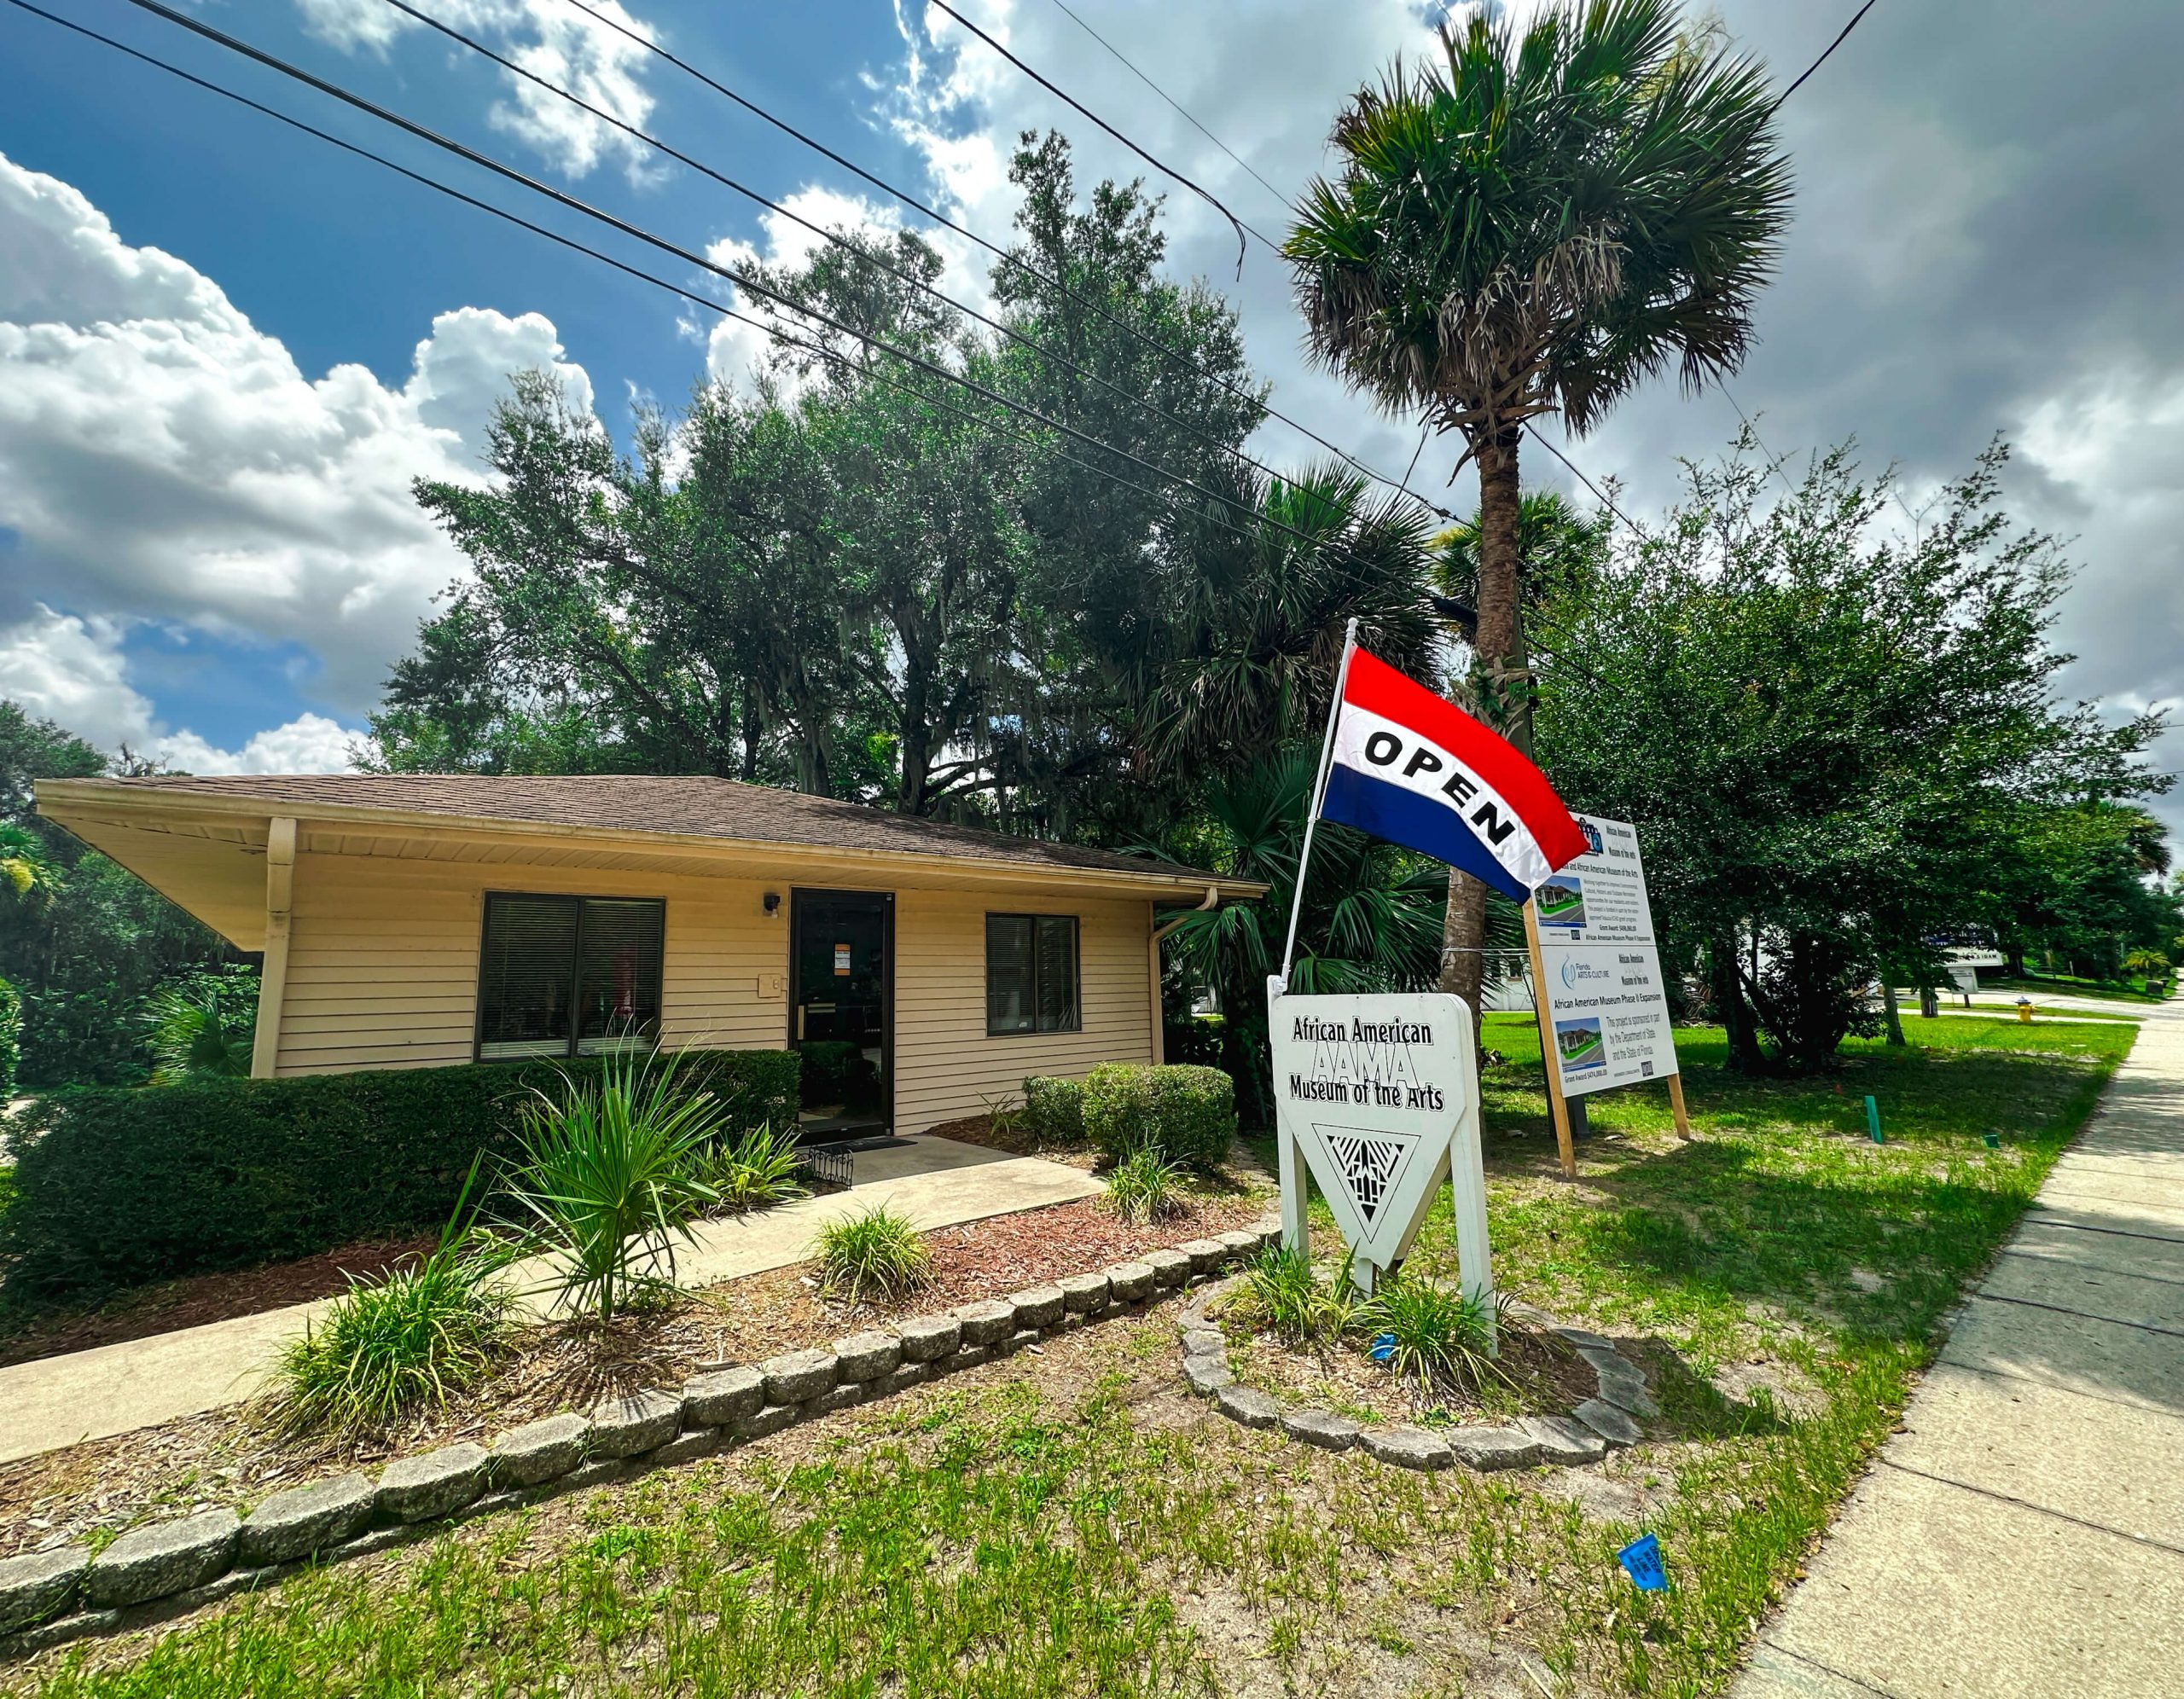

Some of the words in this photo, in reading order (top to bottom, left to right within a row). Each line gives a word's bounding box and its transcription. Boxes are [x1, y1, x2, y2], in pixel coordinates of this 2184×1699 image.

[1365, 731, 1515, 846] OPEN
[1577, 862, 1589, 872] African
[1590, 864, 1606, 873] American
[1577, 962, 1590, 971] Florida
[1578, 971, 1589, 979] ARTS
[1592, 970, 1611, 978] CULTURE
[1554, 999, 1574, 1010] African
[1575, 996, 1599, 1008] American
[1600, 995, 1621, 1006] Museum
[1621, 994, 1635, 1004] Phase
[1640, 993, 1662, 1003] Expansion
[1606, 1017, 1616, 1027] This
[1616, 1017, 1628, 1029] project
[1629, 1017, 1631, 1025] is
[1632, 1015, 1650, 1026] sponsored
[1292, 1015, 1346, 1042] African
[1351, 1015, 1433, 1047] American
[1609, 1034, 1615, 1046] by
[1621, 1030, 1642, 1044] Department
[1642, 1029, 1647, 1040] of
[1647, 1028, 1656, 1039] State
[1626, 1047, 1636, 1058] State
[1637, 1046, 1641, 1056] of
[1310, 1040, 1420, 1089] AAMA
[1565, 1075, 1576, 1083] Grant
[1576, 1072, 1587, 1081] Award
[1289, 1072, 1350, 1104] Museum
[1352, 1079, 1370, 1106] of
[1405, 1082, 1445, 1111] Arts
